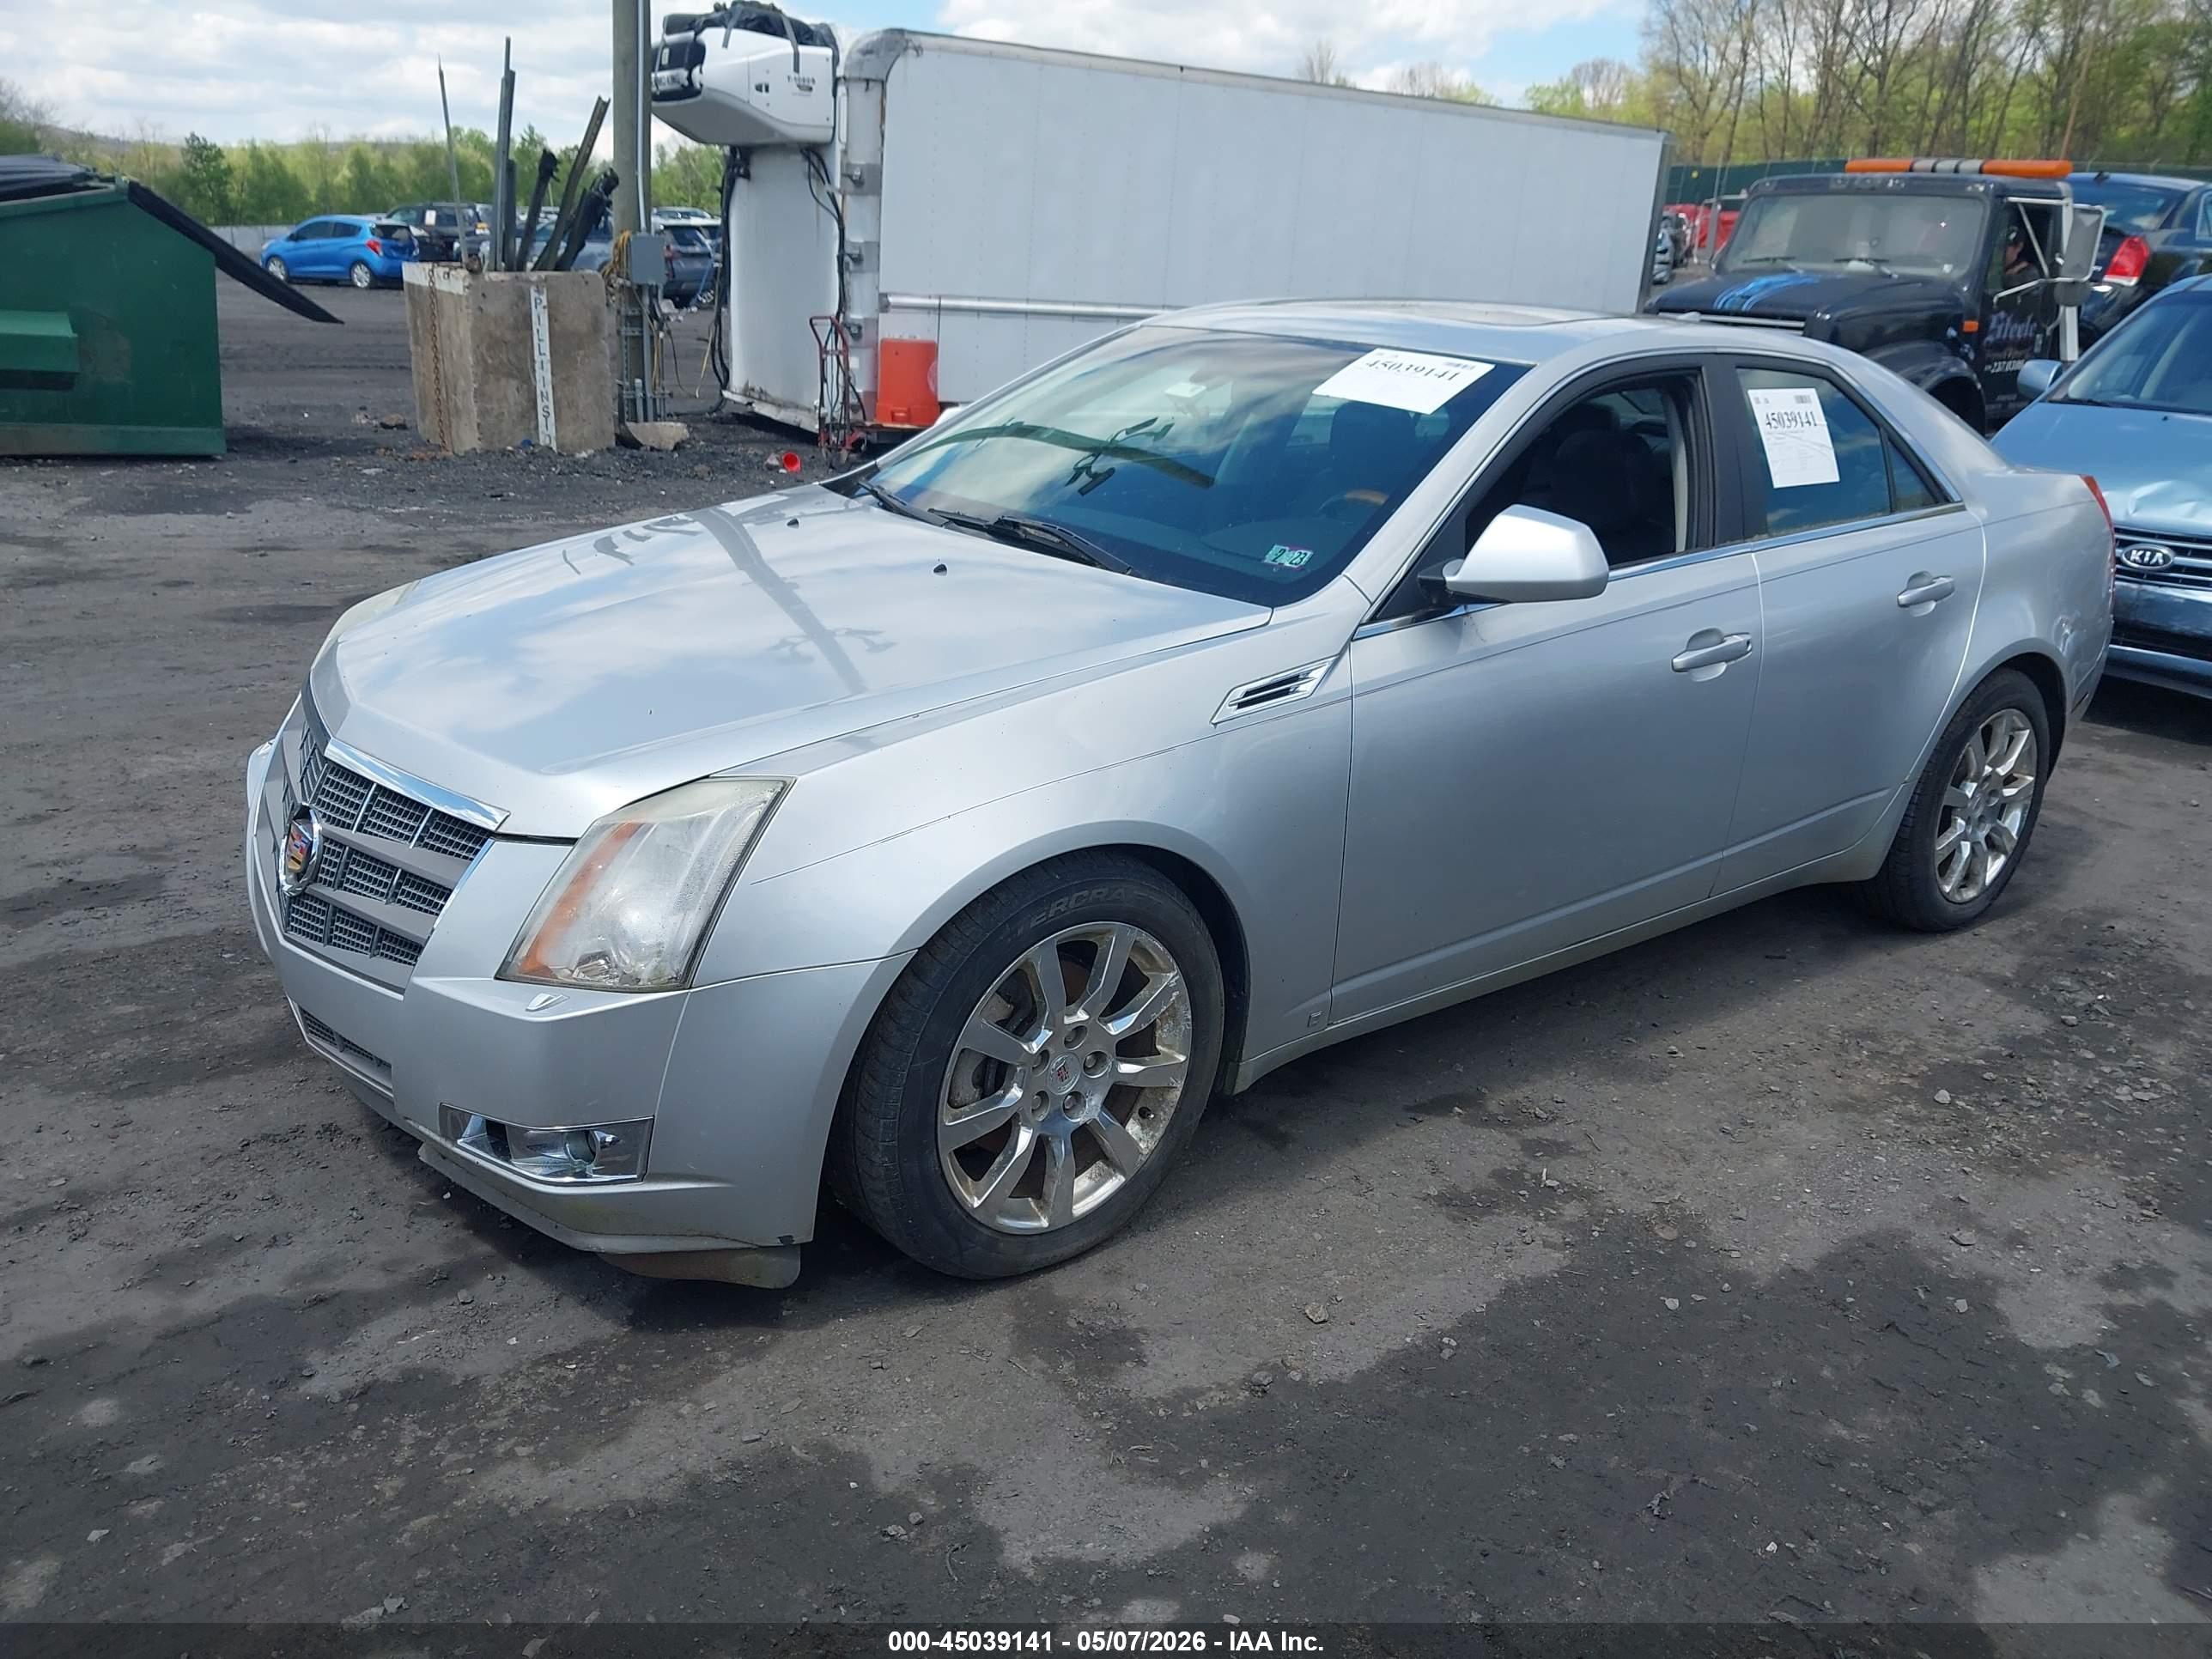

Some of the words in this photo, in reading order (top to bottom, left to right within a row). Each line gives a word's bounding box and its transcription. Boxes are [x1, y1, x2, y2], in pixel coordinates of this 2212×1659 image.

[1765, 410, 1817, 429] 45039141
[1272, 549, 1286, 562] 2
[1289, 551, 1307, 565] 23
[2130, 550, 2164, 565] KIA
